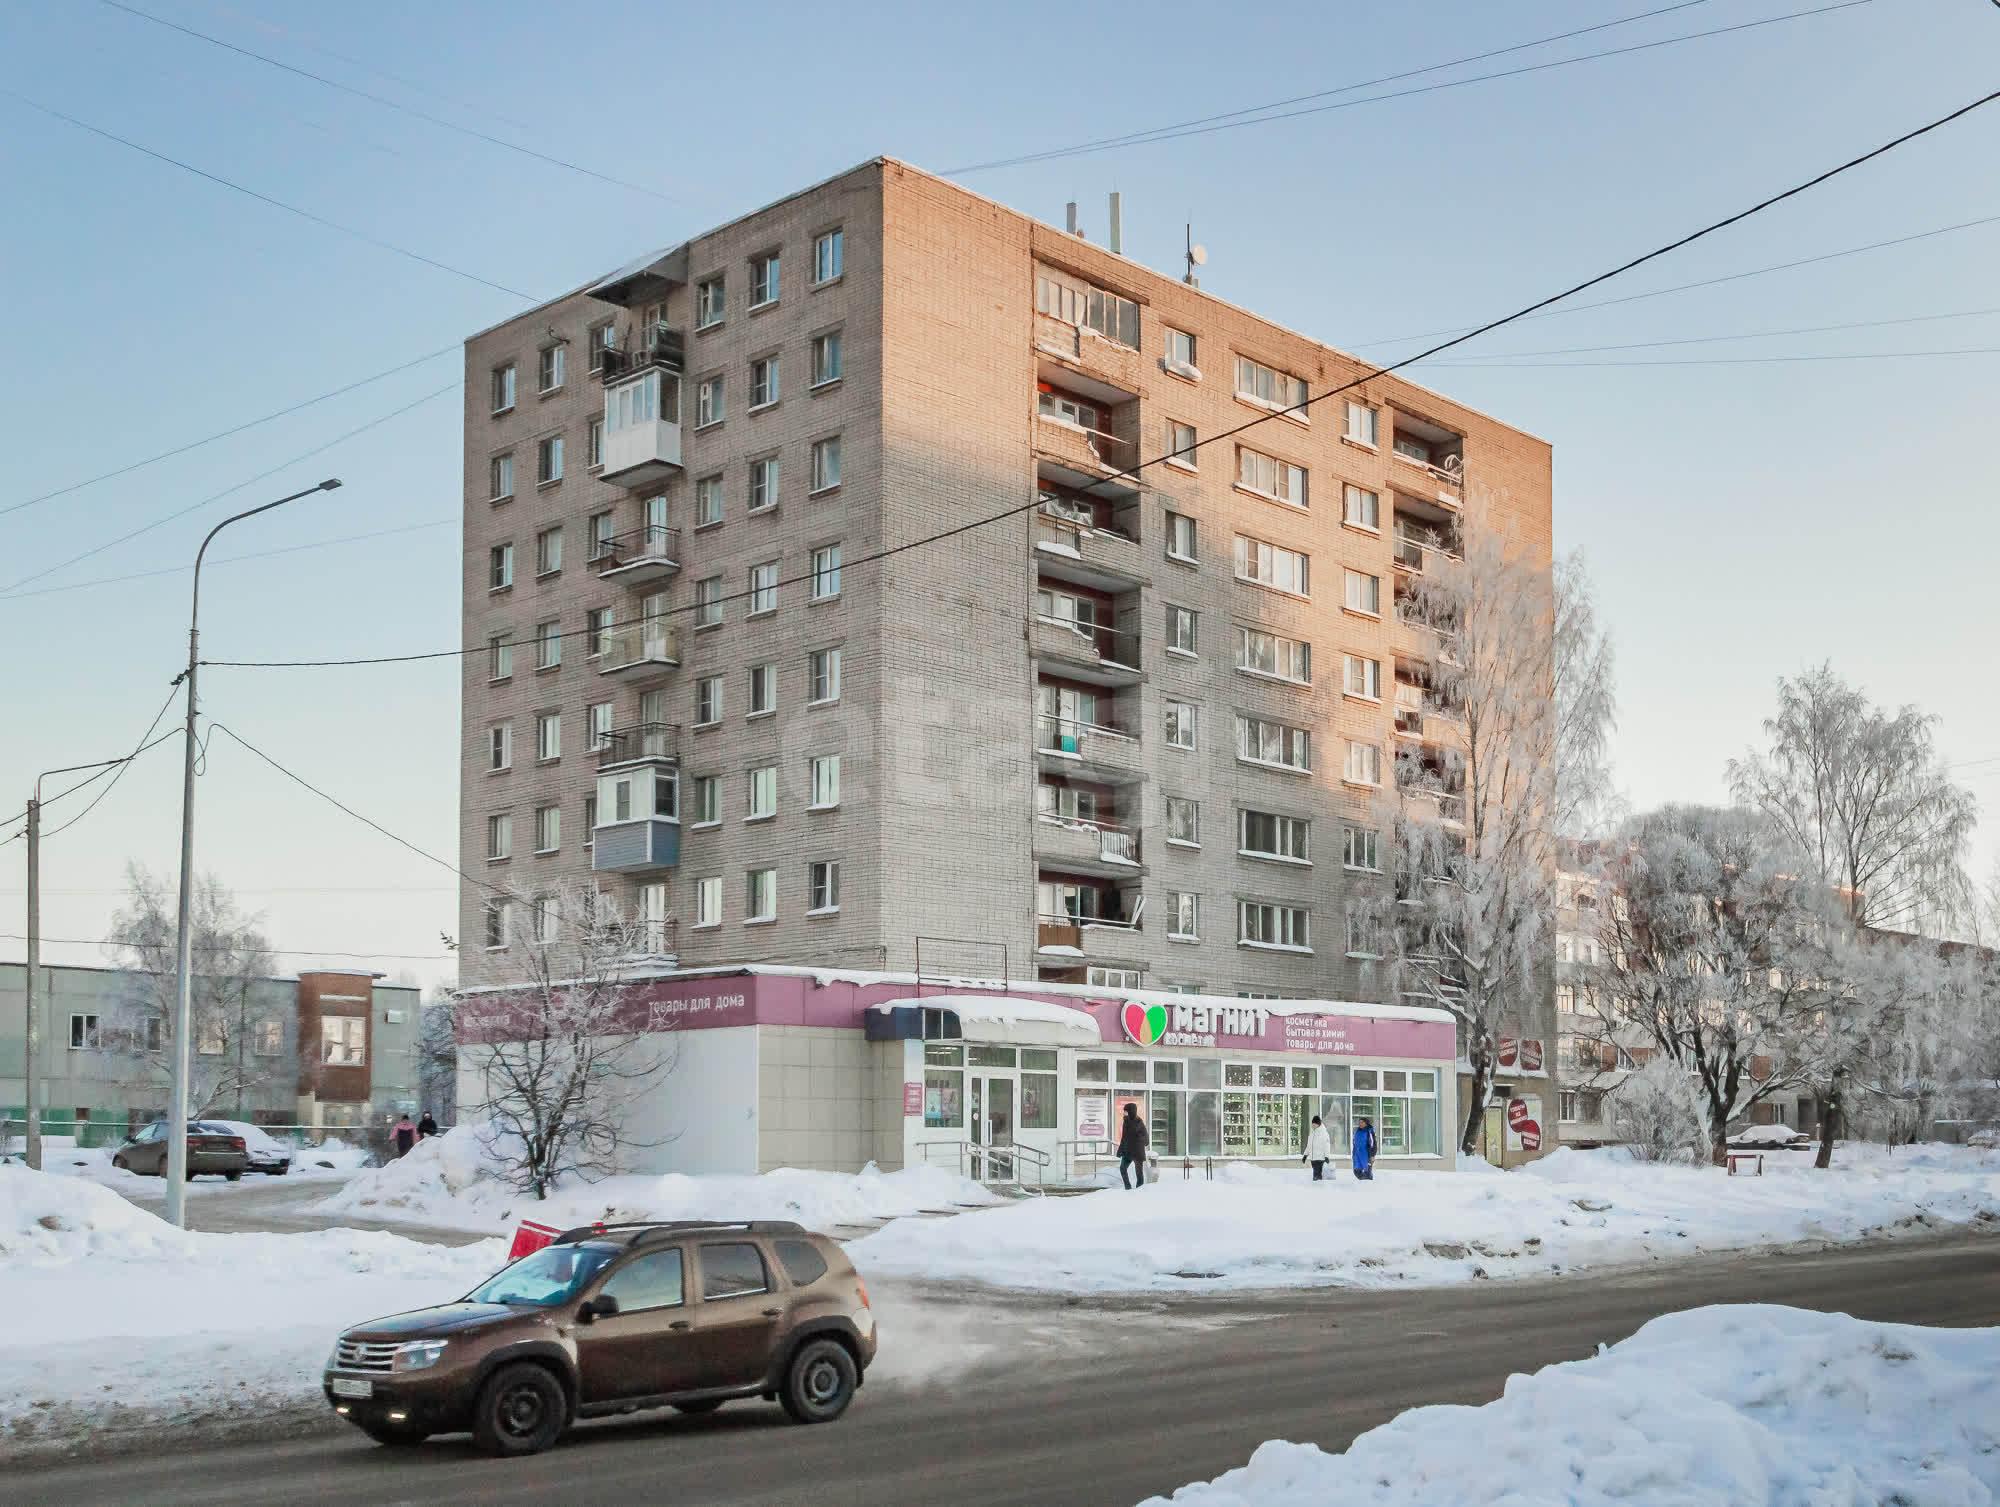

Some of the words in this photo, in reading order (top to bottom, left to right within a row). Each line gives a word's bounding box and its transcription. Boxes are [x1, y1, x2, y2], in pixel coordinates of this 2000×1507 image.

[690, 997, 711, 1013] для
[715, 994, 745, 1011] дома
[1285, 1016, 1328, 1028] косметика
[1285, 1025, 1321, 1038] бытовая
[1322, 1029, 1345, 1039] химия
[1317, 1041, 1333, 1051] для
[1334, 1042, 1355, 1052] дома
